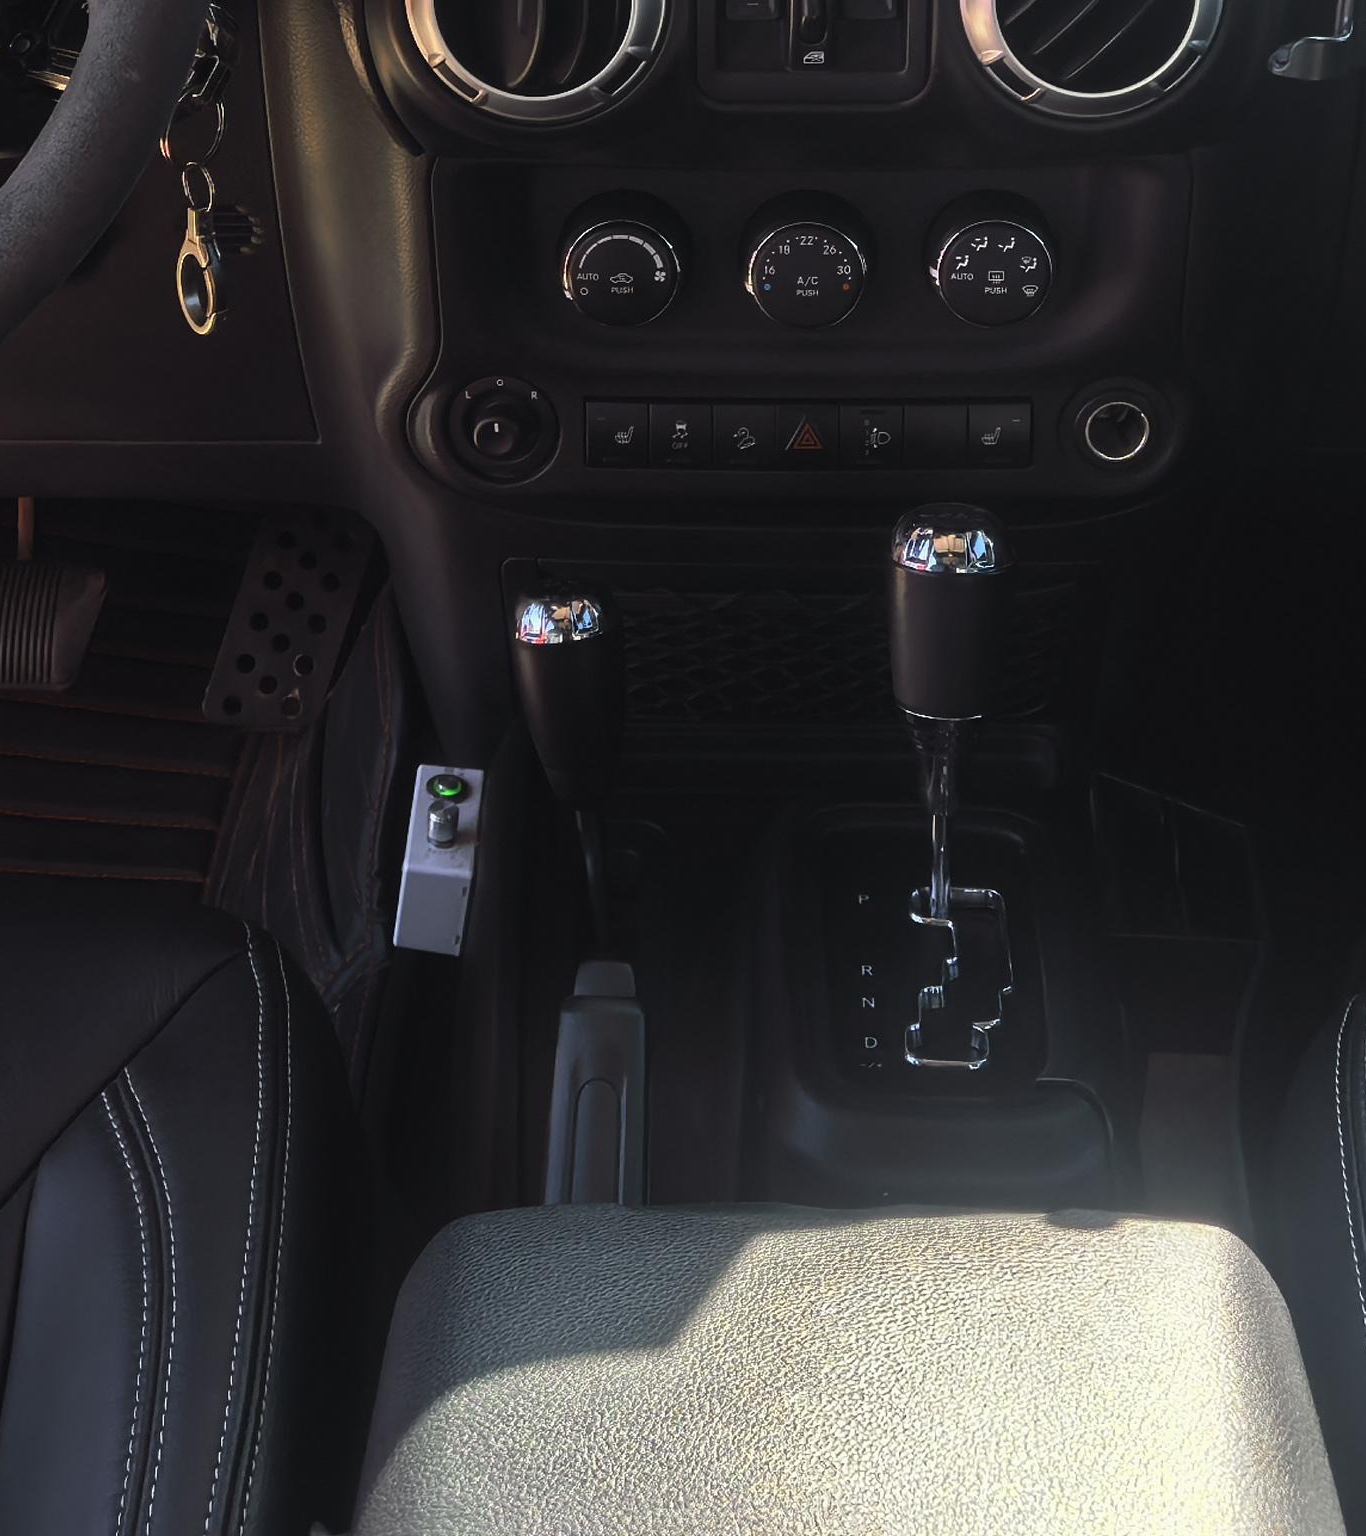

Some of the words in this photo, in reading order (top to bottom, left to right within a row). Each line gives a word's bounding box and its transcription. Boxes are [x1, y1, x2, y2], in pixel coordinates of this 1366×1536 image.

[800, 235, 814, 246] 22
[823, 245, 837, 255] 26
[764, 265, 776, 275] 16
[836, 265, 851, 275] 30
[576, 273, 599, 281] AUTO
[797, 276, 819, 287] A/C
[950, 273, 974, 281] AUTO
[611, 286, 634, 294] PUSH
[984, 286, 1008, 295] PUSH
[465, 391, 471, 399] L
[531, 391, 538, 400] R
[858, 894, 870, 905] P
[861, 965, 873, 976] R
[862, 997, 876, 1009] N
[864, 1036, 878, 1049] D
